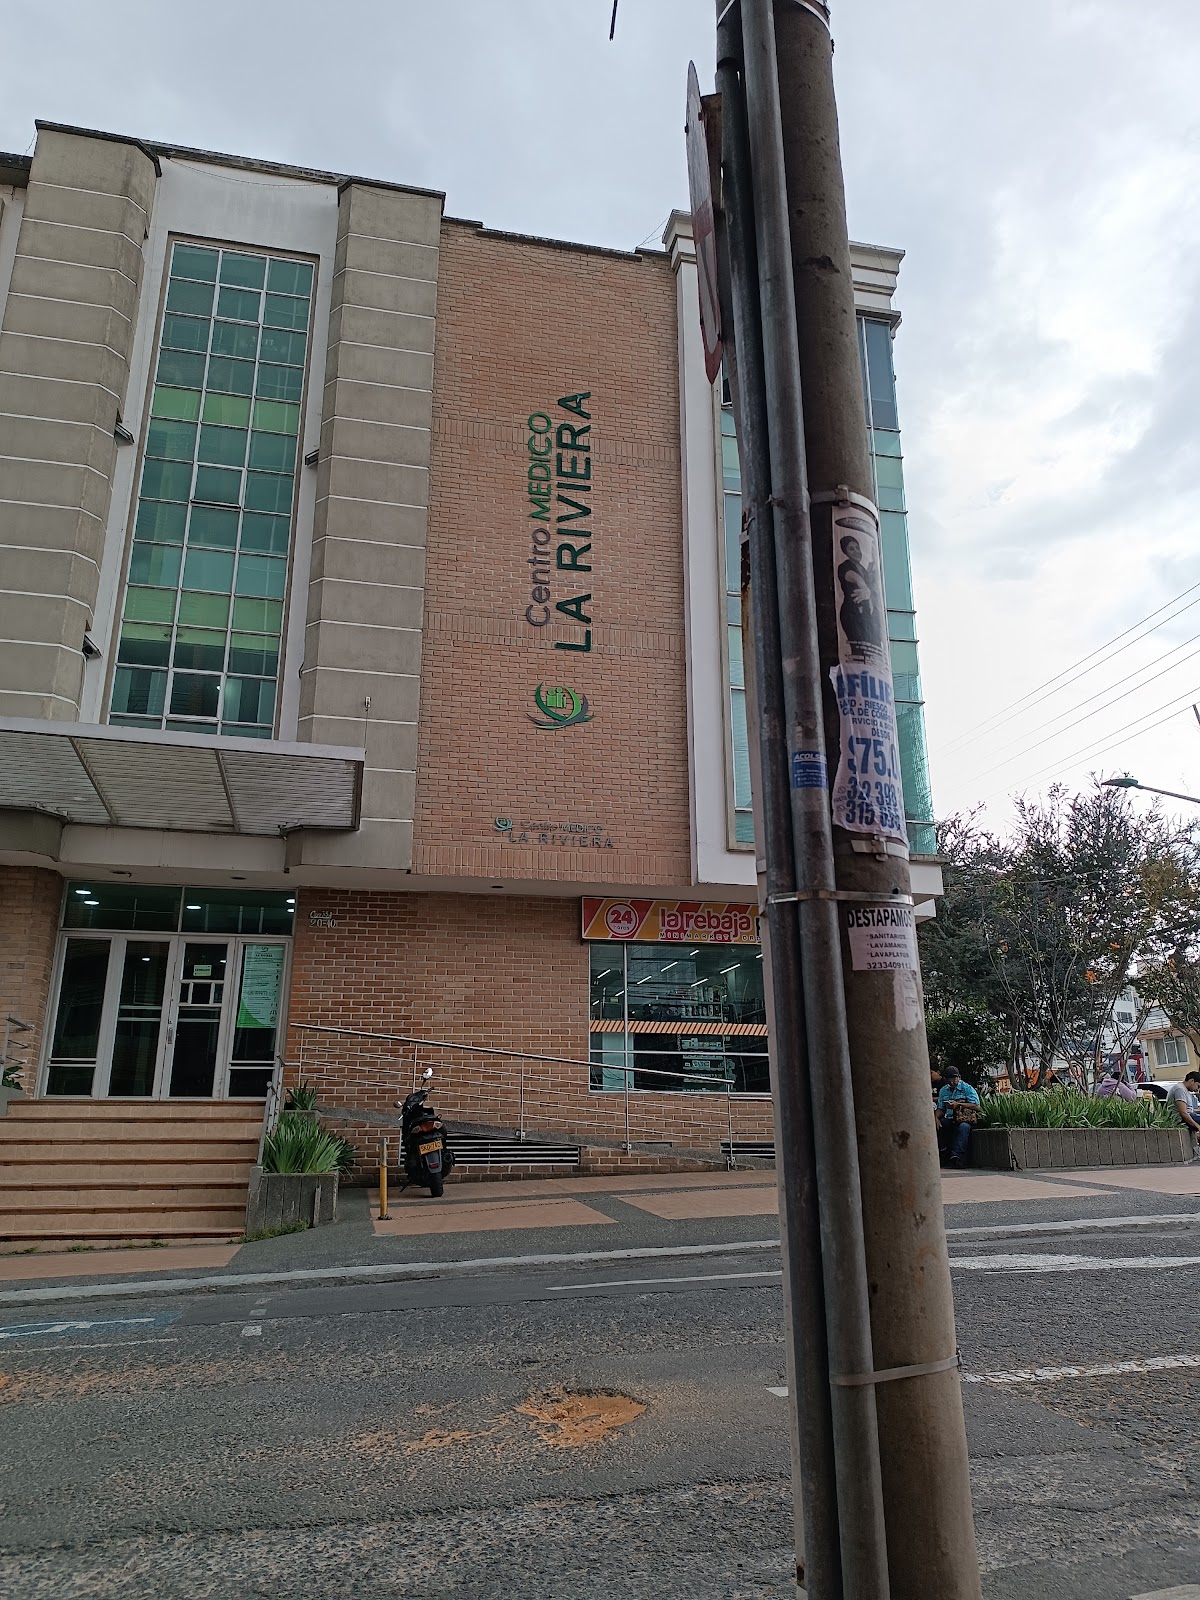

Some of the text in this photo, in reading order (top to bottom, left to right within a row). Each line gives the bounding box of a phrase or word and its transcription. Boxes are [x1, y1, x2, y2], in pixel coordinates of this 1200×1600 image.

[526, 411, 551, 627] Centro MEDICO
[555, 391, 592, 652] LA RIVIERA
[858, 708, 869, 717] DE
[846, 800, 875, 826] 315
[508, 832, 614, 849] LA RIVIERA
[610, 909, 633, 925] 24
[660, 908, 751, 938] la rebaja
[848, 908, 912, 928] DESTAPAMOS
[659, 932, 731, 941] MINIMARKET
